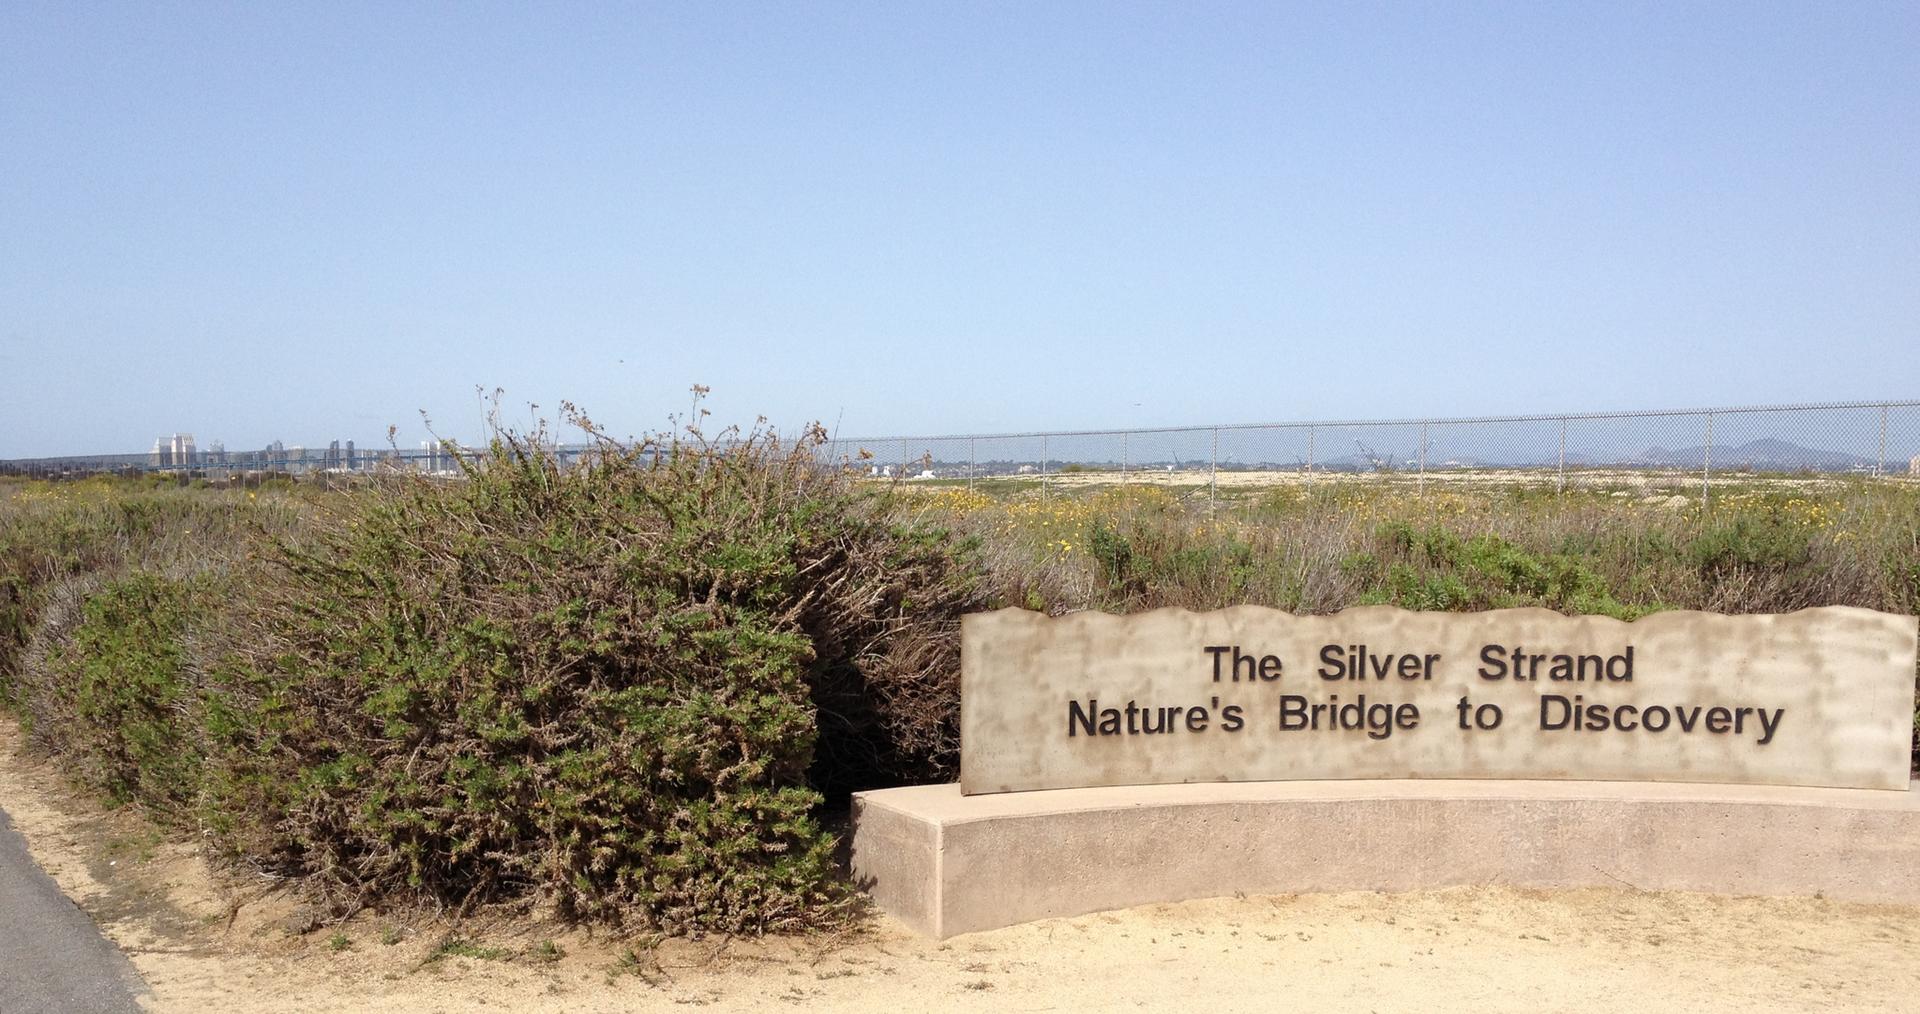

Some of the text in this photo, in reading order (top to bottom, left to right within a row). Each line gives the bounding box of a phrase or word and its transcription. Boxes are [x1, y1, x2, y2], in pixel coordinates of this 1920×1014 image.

[1204, 644, 1634, 681] The Silver Strand
[1069, 694, 1784, 745] Nature's Bridge to Discovery
